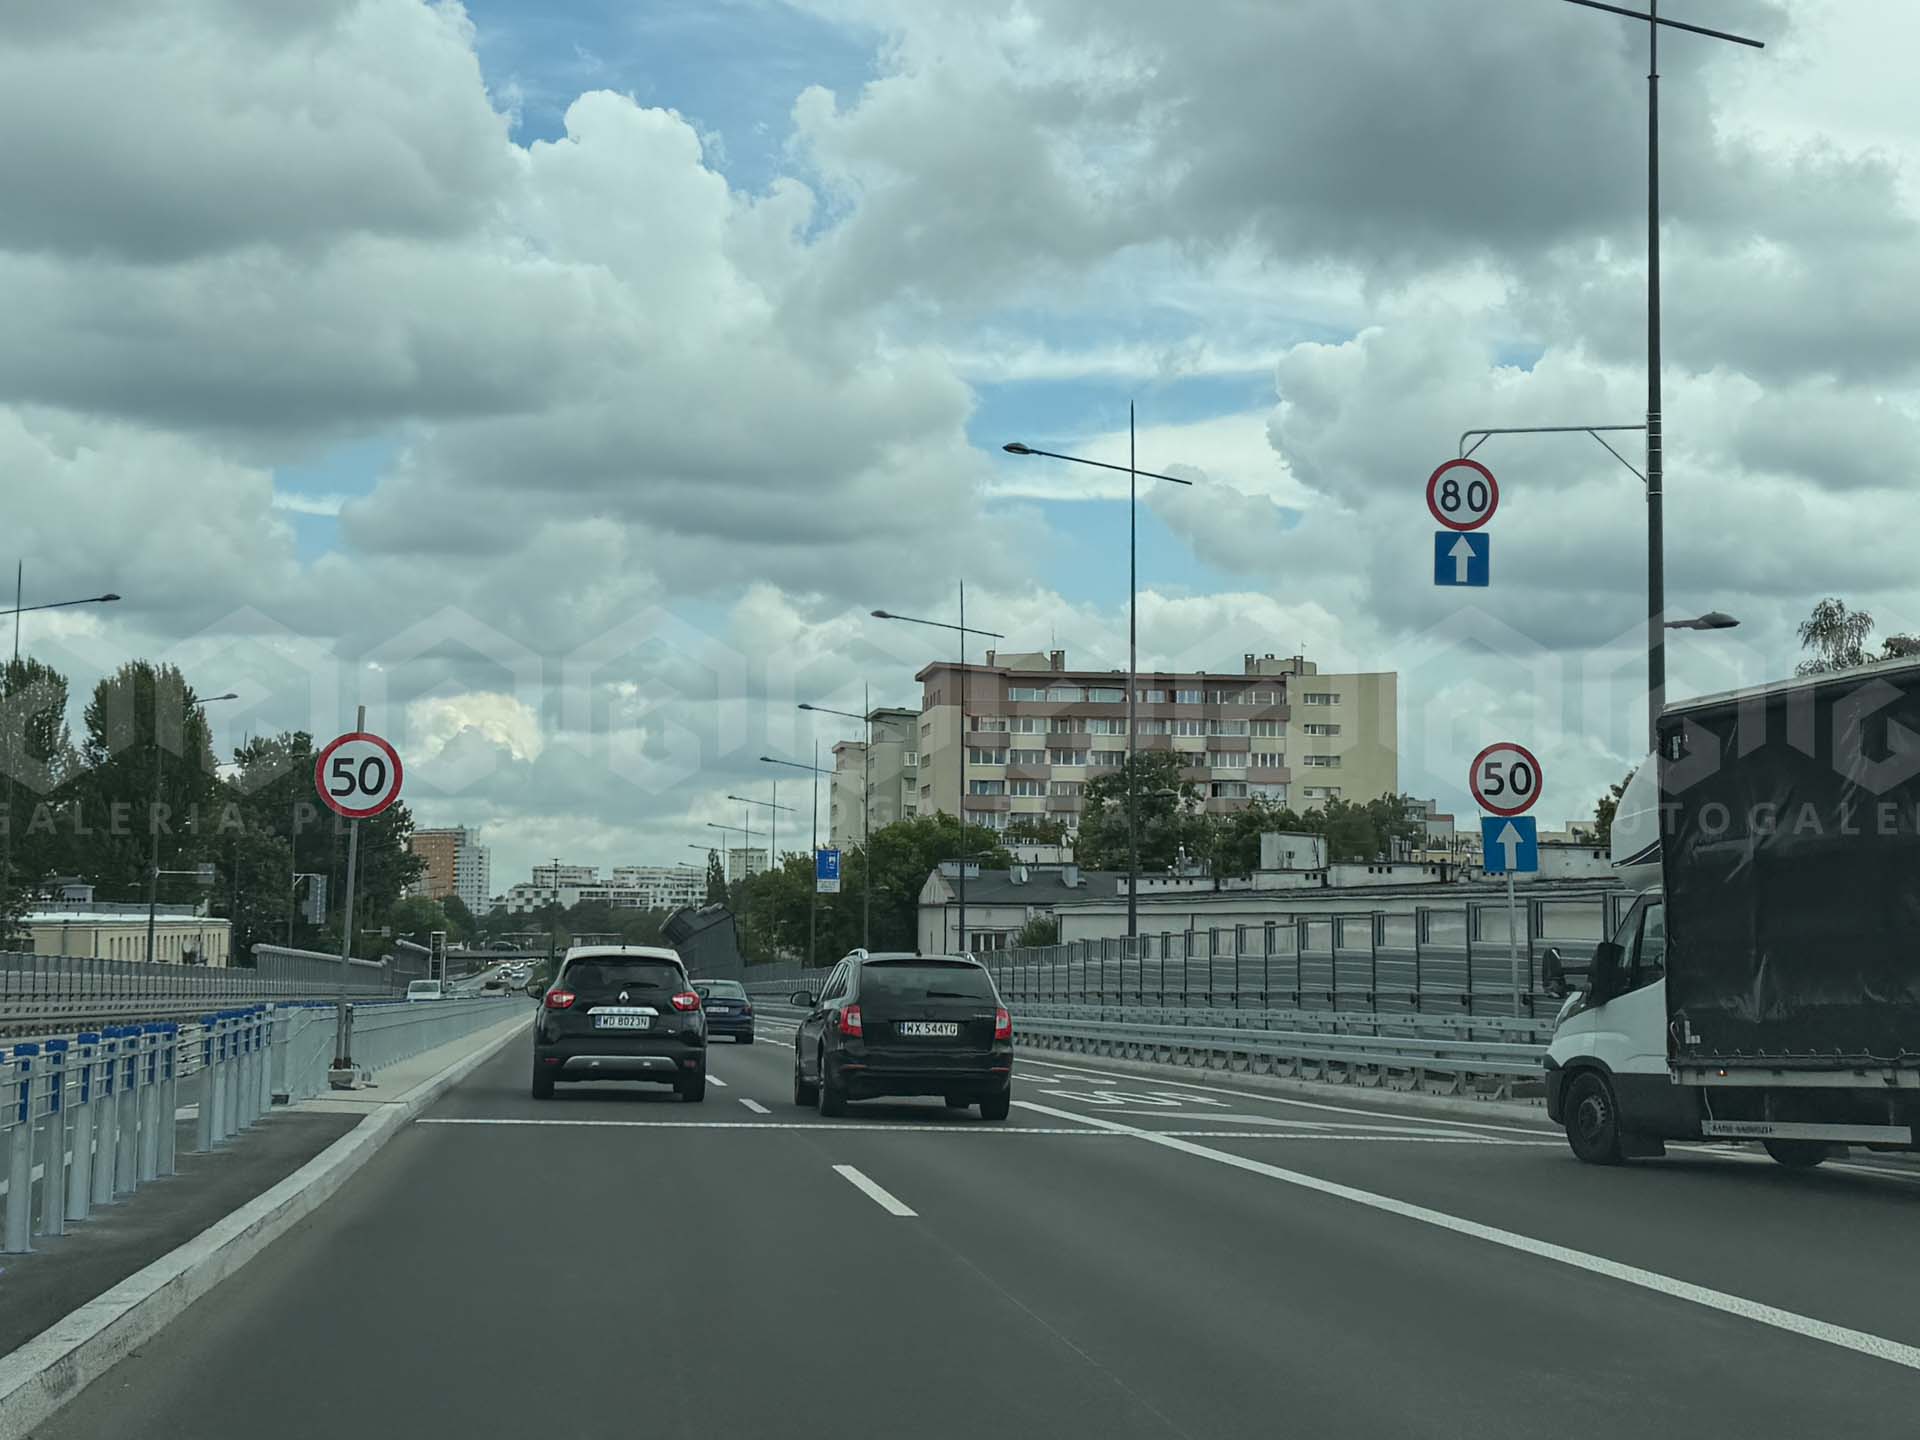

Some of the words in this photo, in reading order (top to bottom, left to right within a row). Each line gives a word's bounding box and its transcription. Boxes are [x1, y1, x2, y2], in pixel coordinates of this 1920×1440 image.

[1441, 480, 1488, 512] 80
[331, 757, 386, 797] 50
[1484, 762, 1532, 796] 50
[602, 1017, 615, 1026] WD
[907, 1023, 921, 1033] WX
[1011, 1072, 1118, 1085] US
